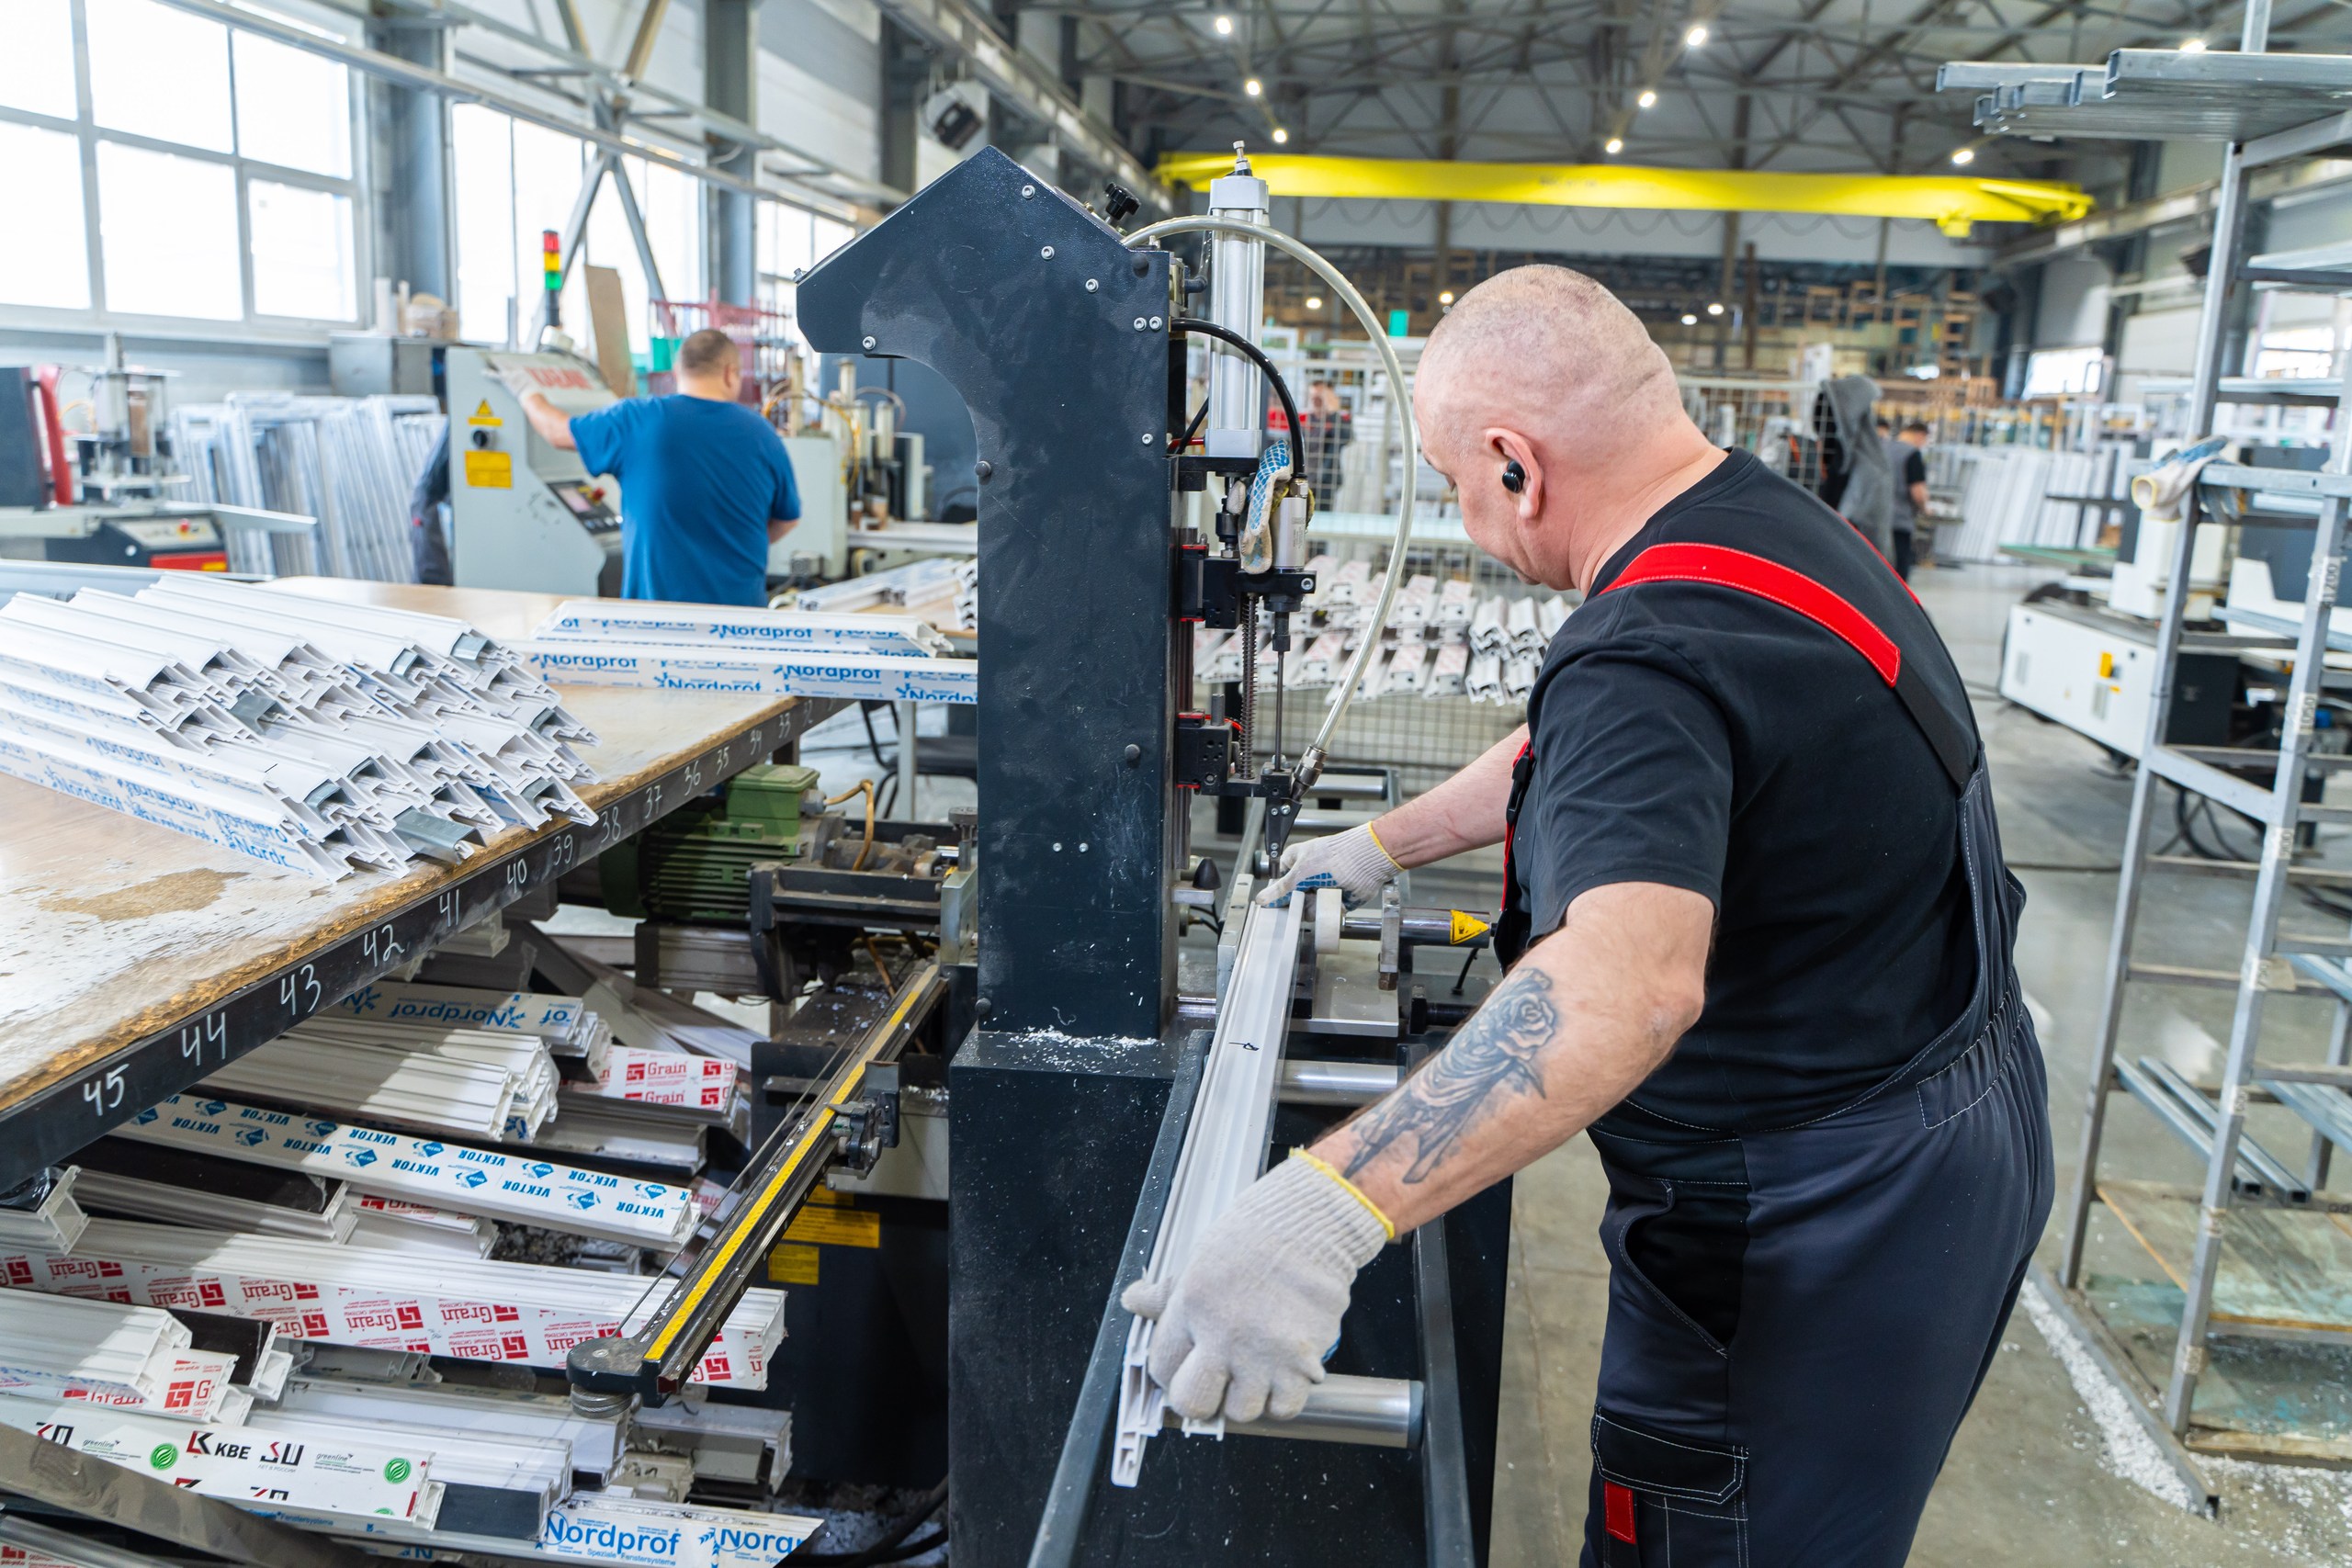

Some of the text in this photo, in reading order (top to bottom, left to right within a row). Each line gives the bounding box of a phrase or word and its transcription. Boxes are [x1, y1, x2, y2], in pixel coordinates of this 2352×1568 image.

[778, 712, 791, 739] 33
[716, 746, 730, 775] 35
[684, 759, 702, 796] 36
[645, 784, 663, 818] 37
[600, 806, 622, 843] 38
[553, 833, 573, 866] 39
[506, 857, 527, 895] 40
[439, 888, 459, 927] 41
[363, 923, 405, 967] 42
[279, 964, 322, 1016] 43
[388, 1001, 506, 1028] Nordprof
[181, 1011, 227, 1066] 44
[648, 1062, 687, 1076] Grain
[83, 1063, 130, 1116] 45
[172, 1116, 221, 1134] VEKTOR
[283, 1137, 333, 1156] VEKTOR
[349, 1128, 398, 1146] VEKTOR
[391, 1158, 441, 1177] VEKTOR
[458, 1148, 507, 1167] VEKTOR
[502, 1179, 551, 1198] VEKTOR
[616, 1201, 665, 1219] VEKTOR
[49, 1260, 98, 1280] Grain
[150, 1291, 200, 1309] Grain
[242, 1282, 293, 1302] Grain
[345, 1313, 397, 1333] Grain
[441, 1305, 492, 1325] Grain
[450, 1343, 503, 1361] Grain
[214, 1442, 252, 1460] KBE
[316, 1452, 348, 1461] greenline
[547, 1516, 682, 1556] Nordprof
[620, 1551, 677, 1566] Fenstersysteme
